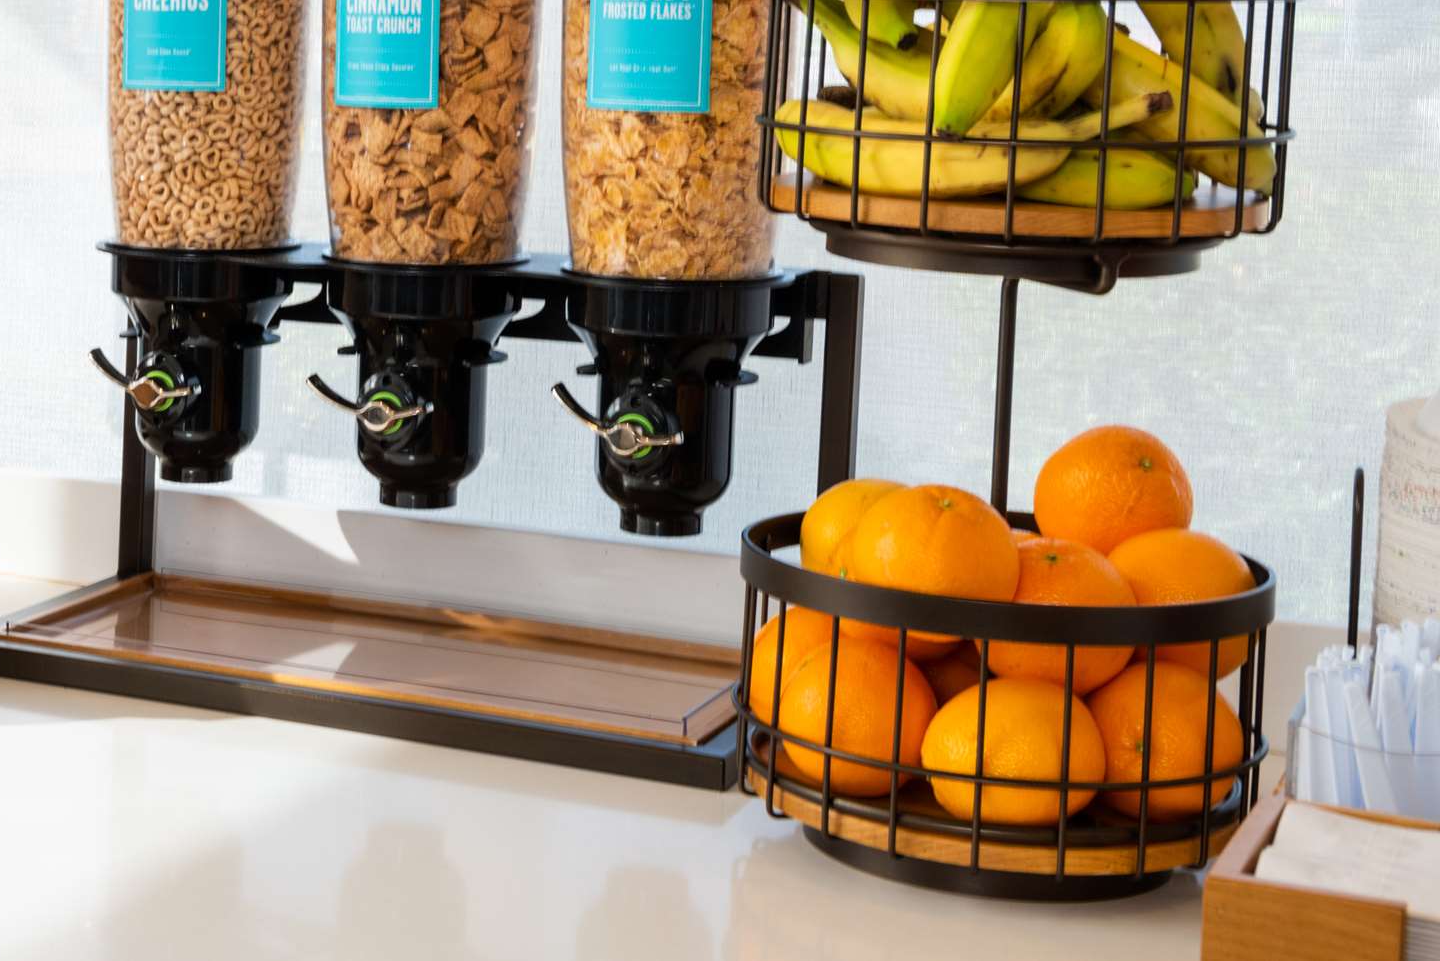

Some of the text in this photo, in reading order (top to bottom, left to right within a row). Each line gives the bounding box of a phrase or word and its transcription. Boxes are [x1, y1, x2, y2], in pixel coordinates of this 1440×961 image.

[602, 1, 693, 21] FROSTED FLAKES
[346, 15, 421, 35] TOAST CRUNCH
